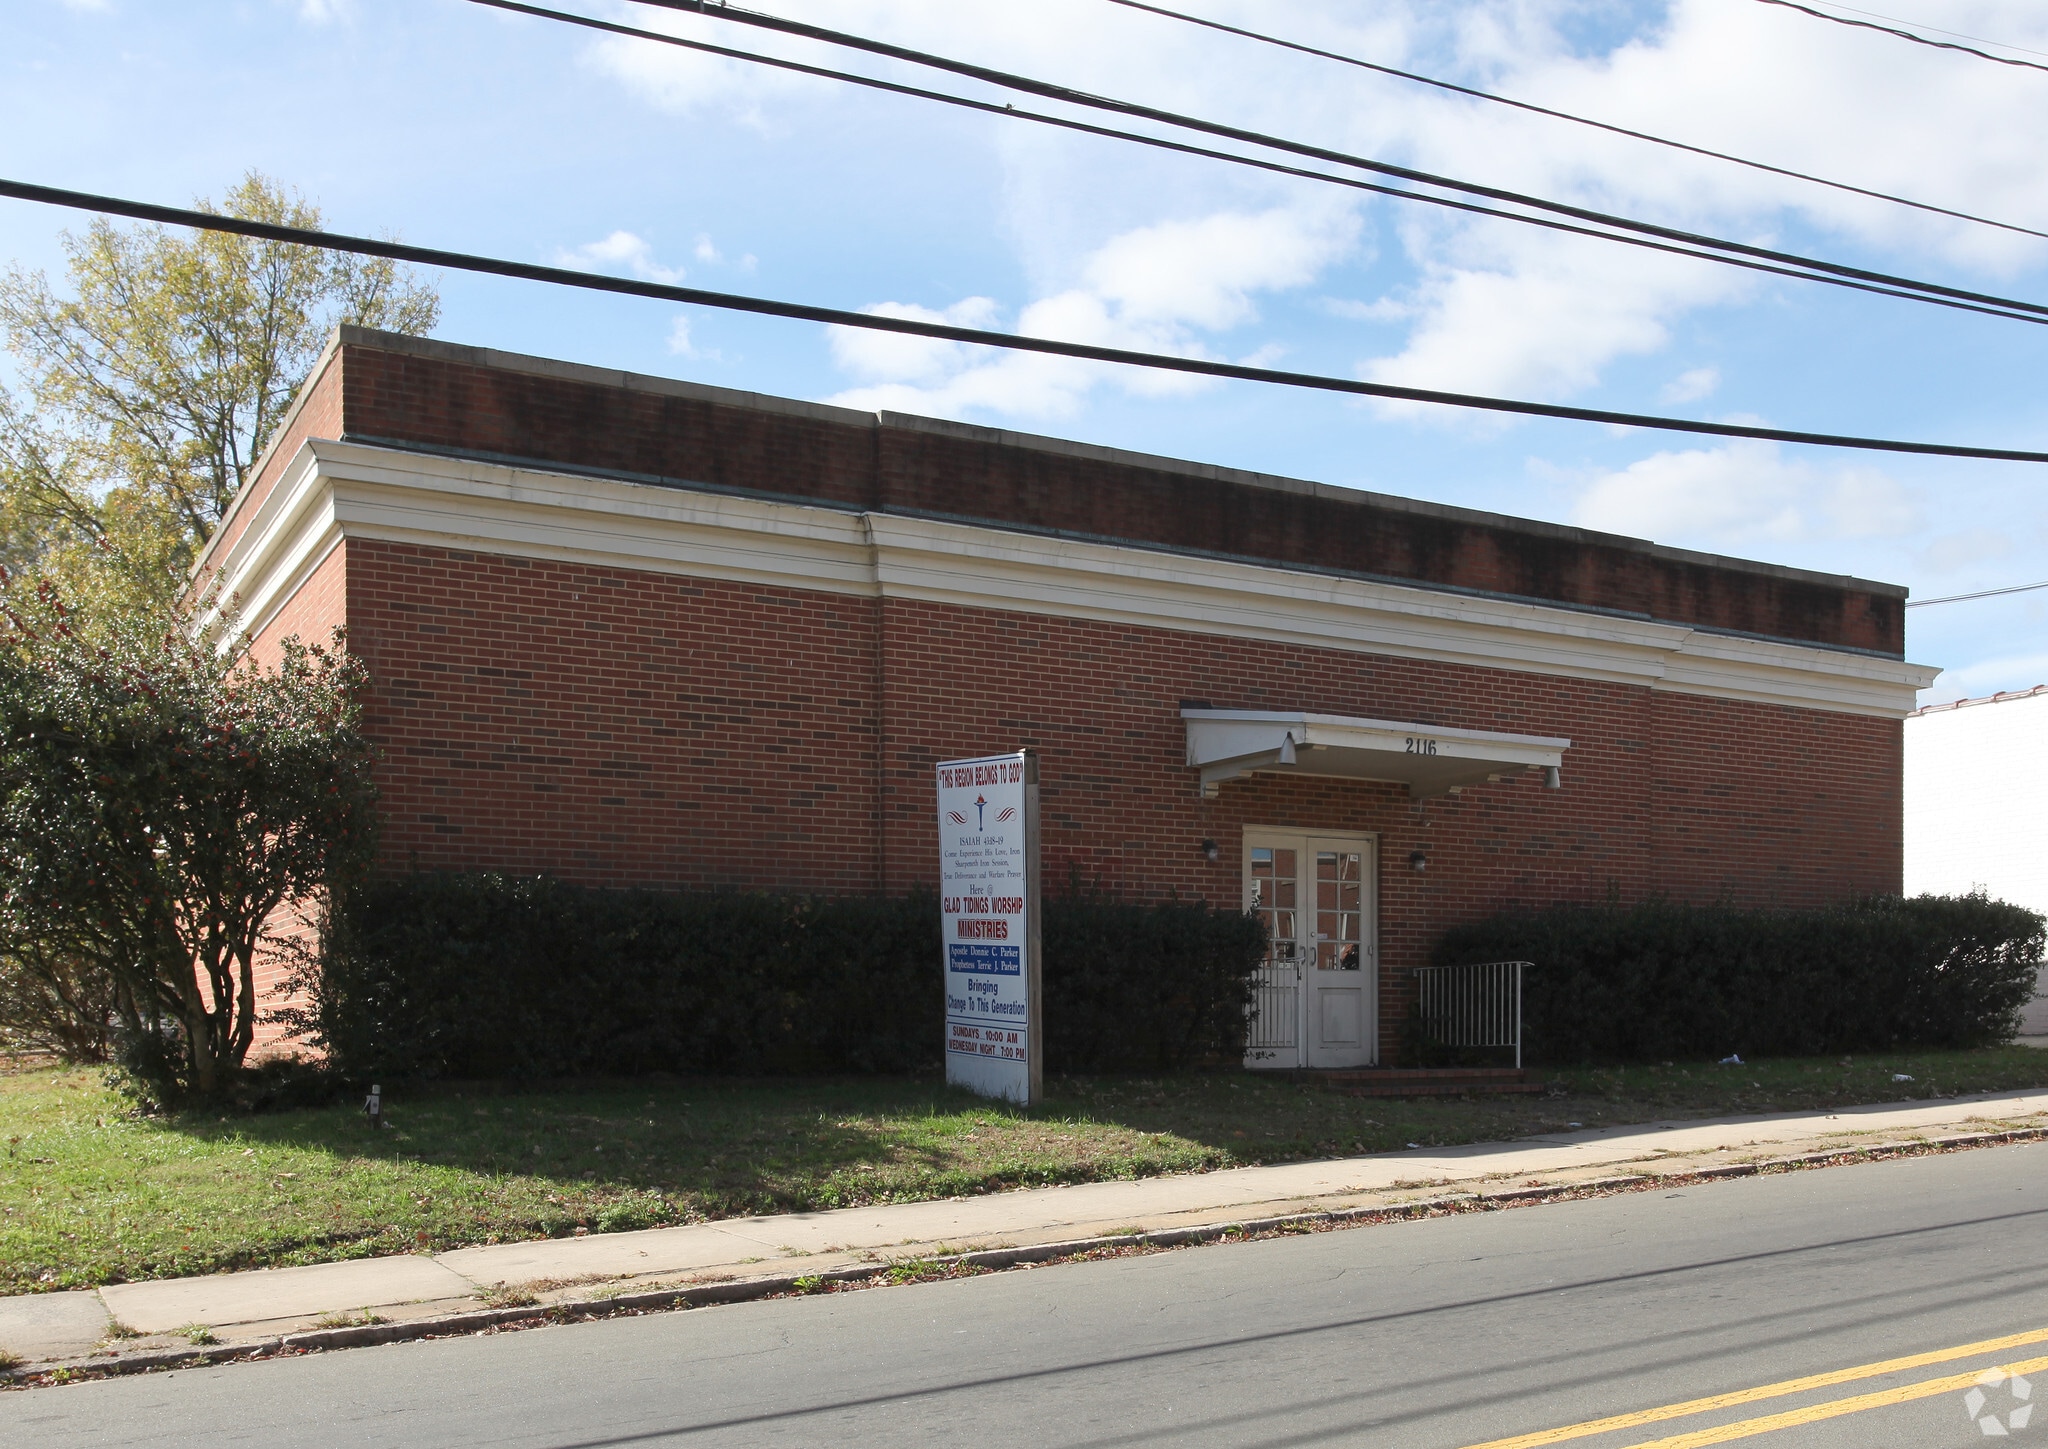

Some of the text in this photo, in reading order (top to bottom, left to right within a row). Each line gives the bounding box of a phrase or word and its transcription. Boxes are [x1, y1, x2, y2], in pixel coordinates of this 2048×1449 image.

[1406, 737, 1437, 756] 2116
[955, 767, 974, 788] REGION
[975, 764, 998, 786] BELONGS
[1000, 763, 1007, 784] TO
[960, 836, 981, 846] ISAIAH
[944, 850, 957, 858] Come
[959, 849, 983, 858] Experience
[985, 848, 993, 856] His
[1009, 847, 1020, 855] Iron
[954, 859, 979, 868] Sharpeneth
[954, 871, 977, 880] Deliverance
[1007, 870, 1021, 878] Prayer
[969, 884, 993, 896] Here @
[944, 896, 1023, 914] GLAD TIDINGS WORSHIP
[957, 919, 1009, 940] MINISTRIES
[950, 946, 1018, 957] Apostle Donnie C. Parker
[951, 958, 975, 970] Prophetess
[977, 959, 992, 970] Terrie
[1001, 961, 1018, 972] Parker
[968, 978, 998, 996] Bringing
[948, 994, 1025, 1016] Change To This Generation
[952, 1025, 1018, 1044] SUNDAYS 10:00 AM
[948, 1039, 1025, 1059] WEDNESDAY NIGHT 7:00 PM
